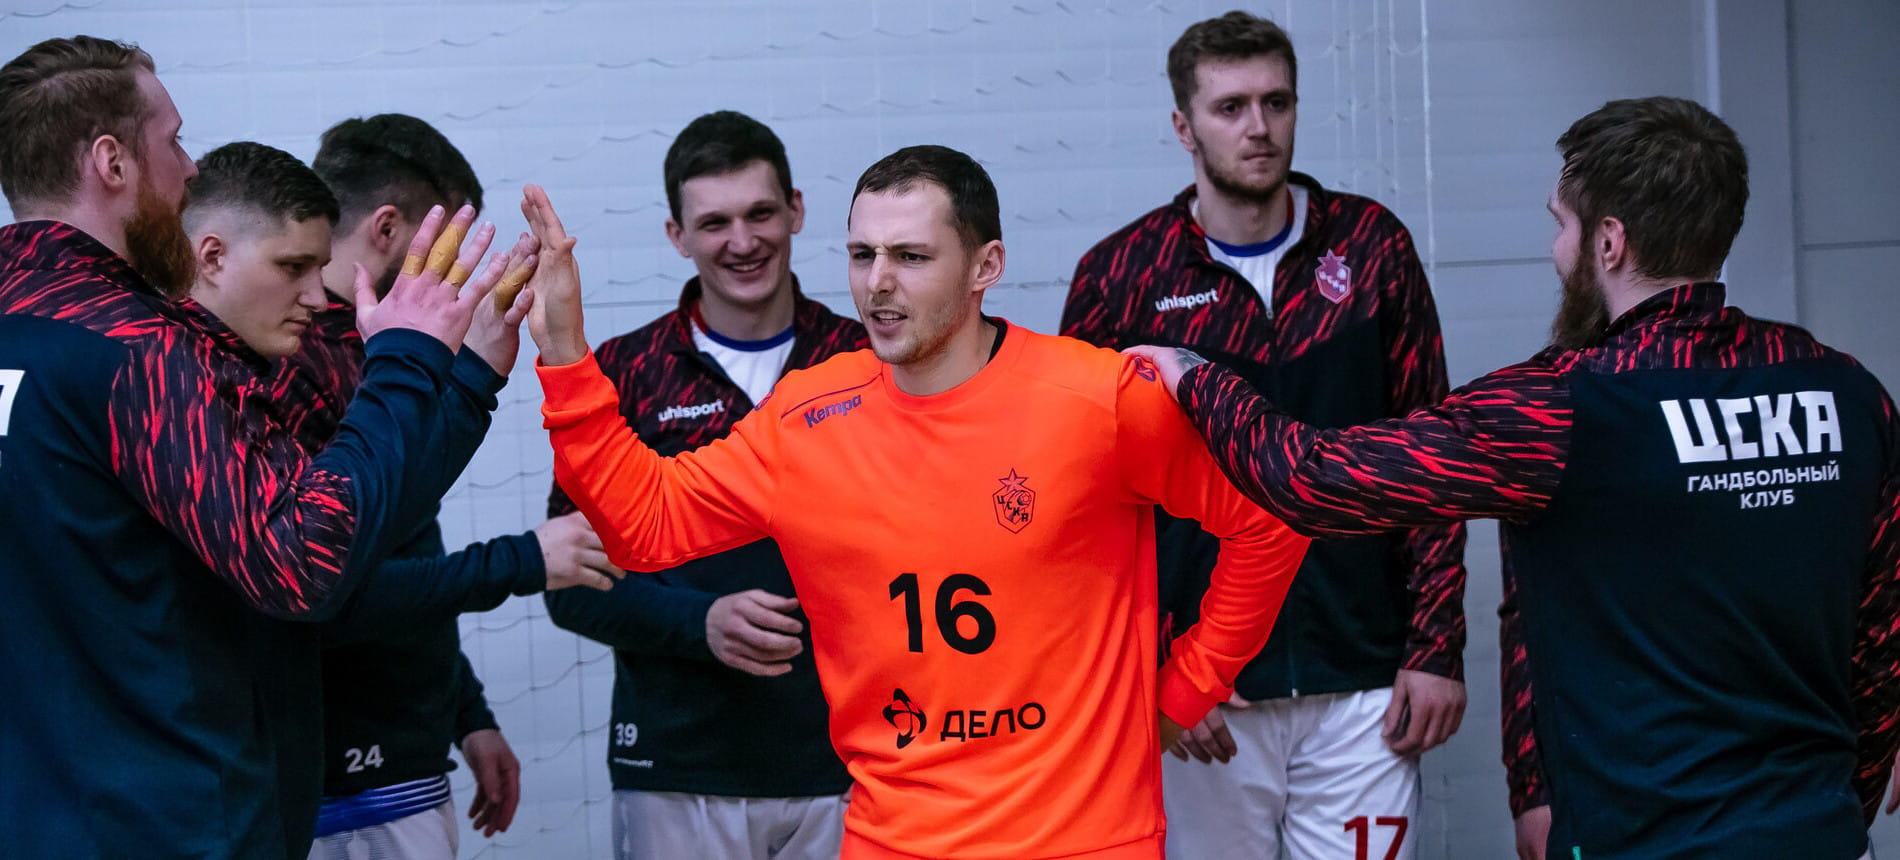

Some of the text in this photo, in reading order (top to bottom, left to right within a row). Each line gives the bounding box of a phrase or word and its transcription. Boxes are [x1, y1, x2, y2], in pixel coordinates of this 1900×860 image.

[1155, 288, 1219, 312] uhlsport
[658, 399, 725, 422] uhlsport
[804, 394, 862, 428] Kempa
[1660, 391, 1843, 464] ЦСКА
[1687, 460, 1840, 492] ГАНДБОЛЬНЫЙ
[1740, 489, 1795, 509] КЛУБ
[889, 573, 996, 655] 16
[615, 722, 638, 747] 39
[940, 702, 1046, 742] ДЕЛО
[345, 744, 384, 774] 24
[1344, 815, 1408, 860] 17
